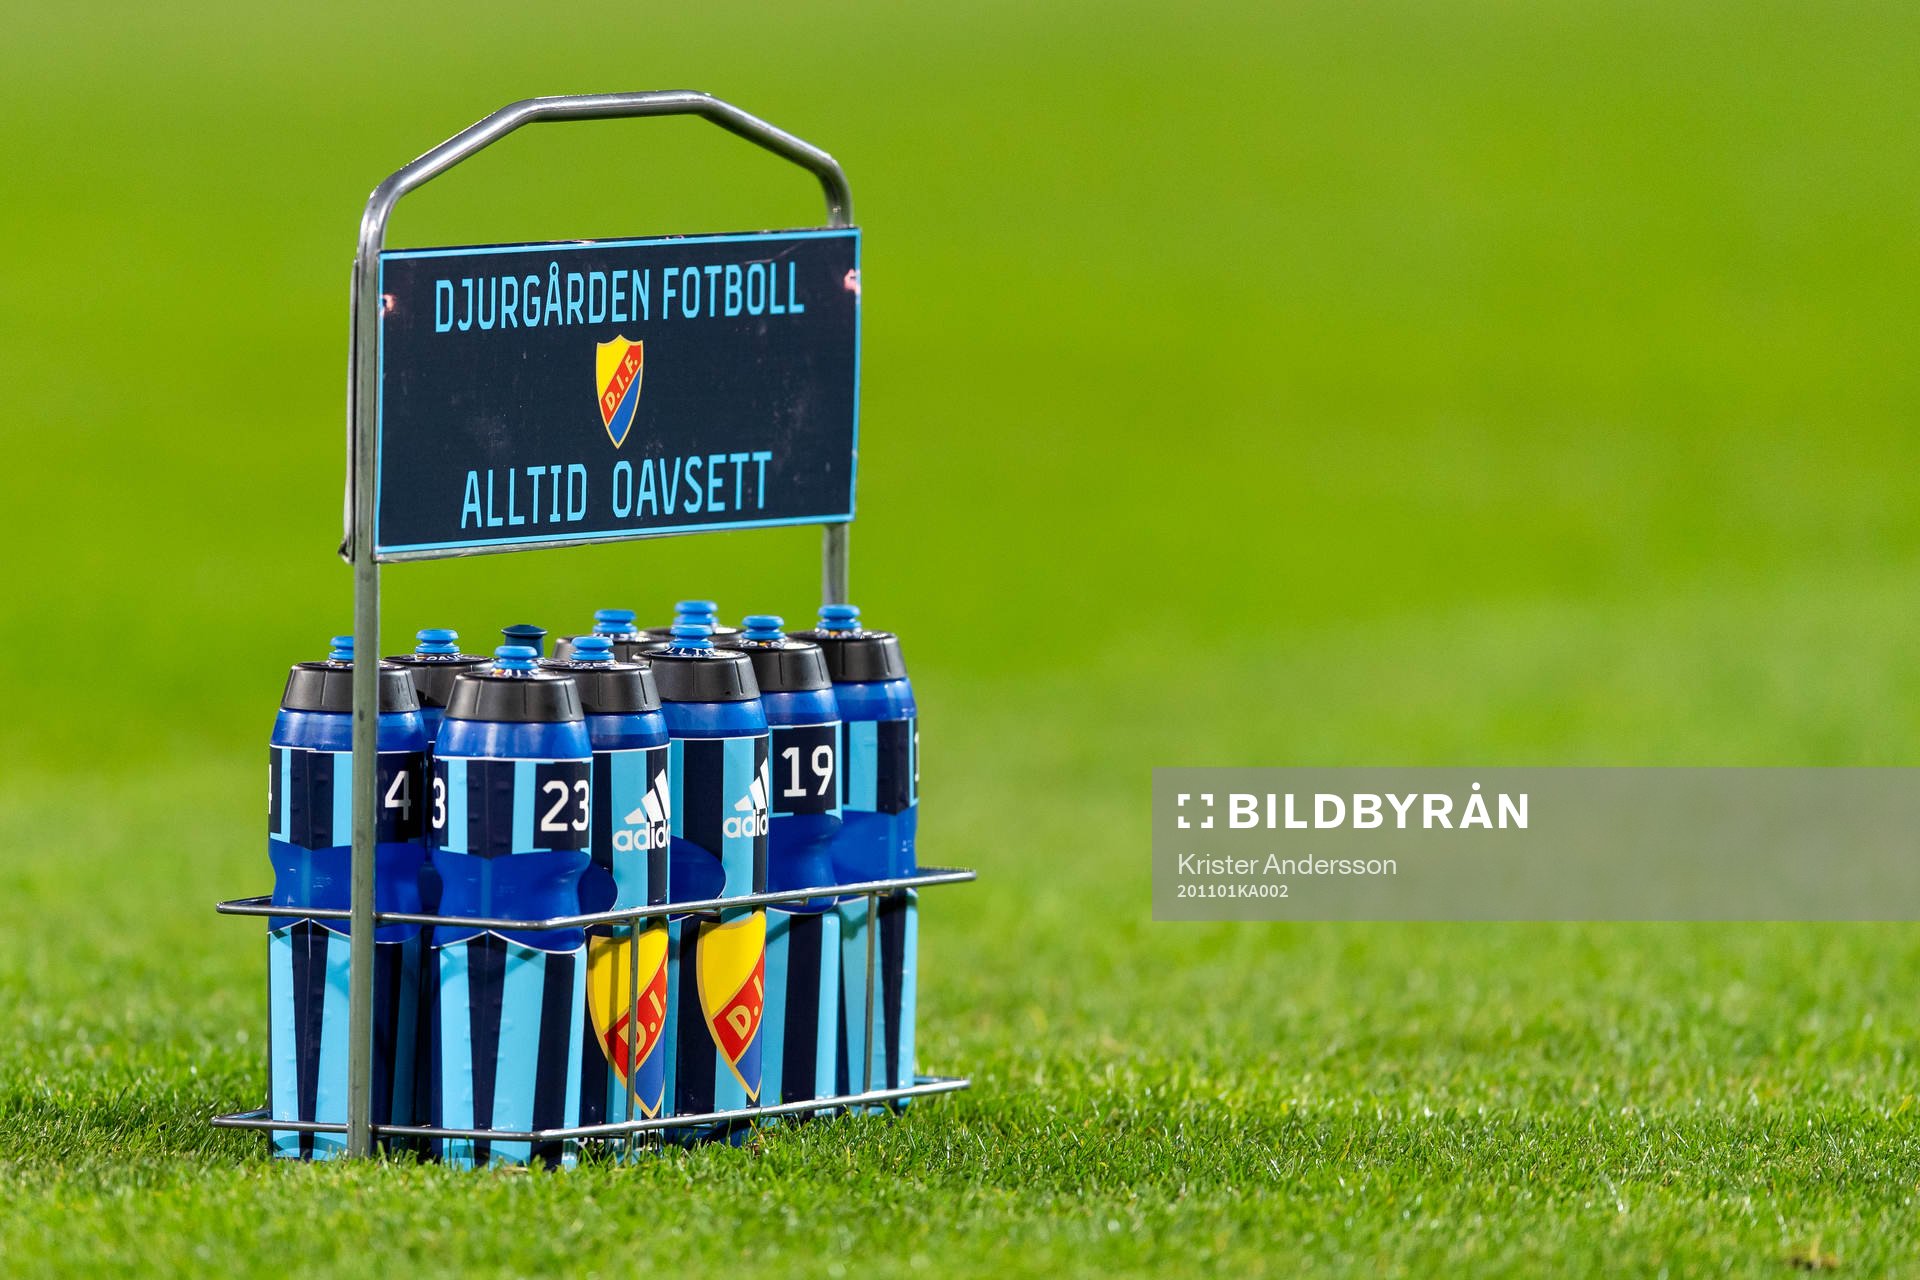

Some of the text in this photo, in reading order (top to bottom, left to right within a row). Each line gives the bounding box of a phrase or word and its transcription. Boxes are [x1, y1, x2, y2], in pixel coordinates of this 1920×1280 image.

[435, 261, 805, 333] DJURGÅRDEN FOTBOLL
[605, 354, 639, 412] D.I.F.
[460, 451, 773, 529] ALLTID OAVSETT
[780, 744, 834, 798] 19
[540, 779, 590, 832] 23
